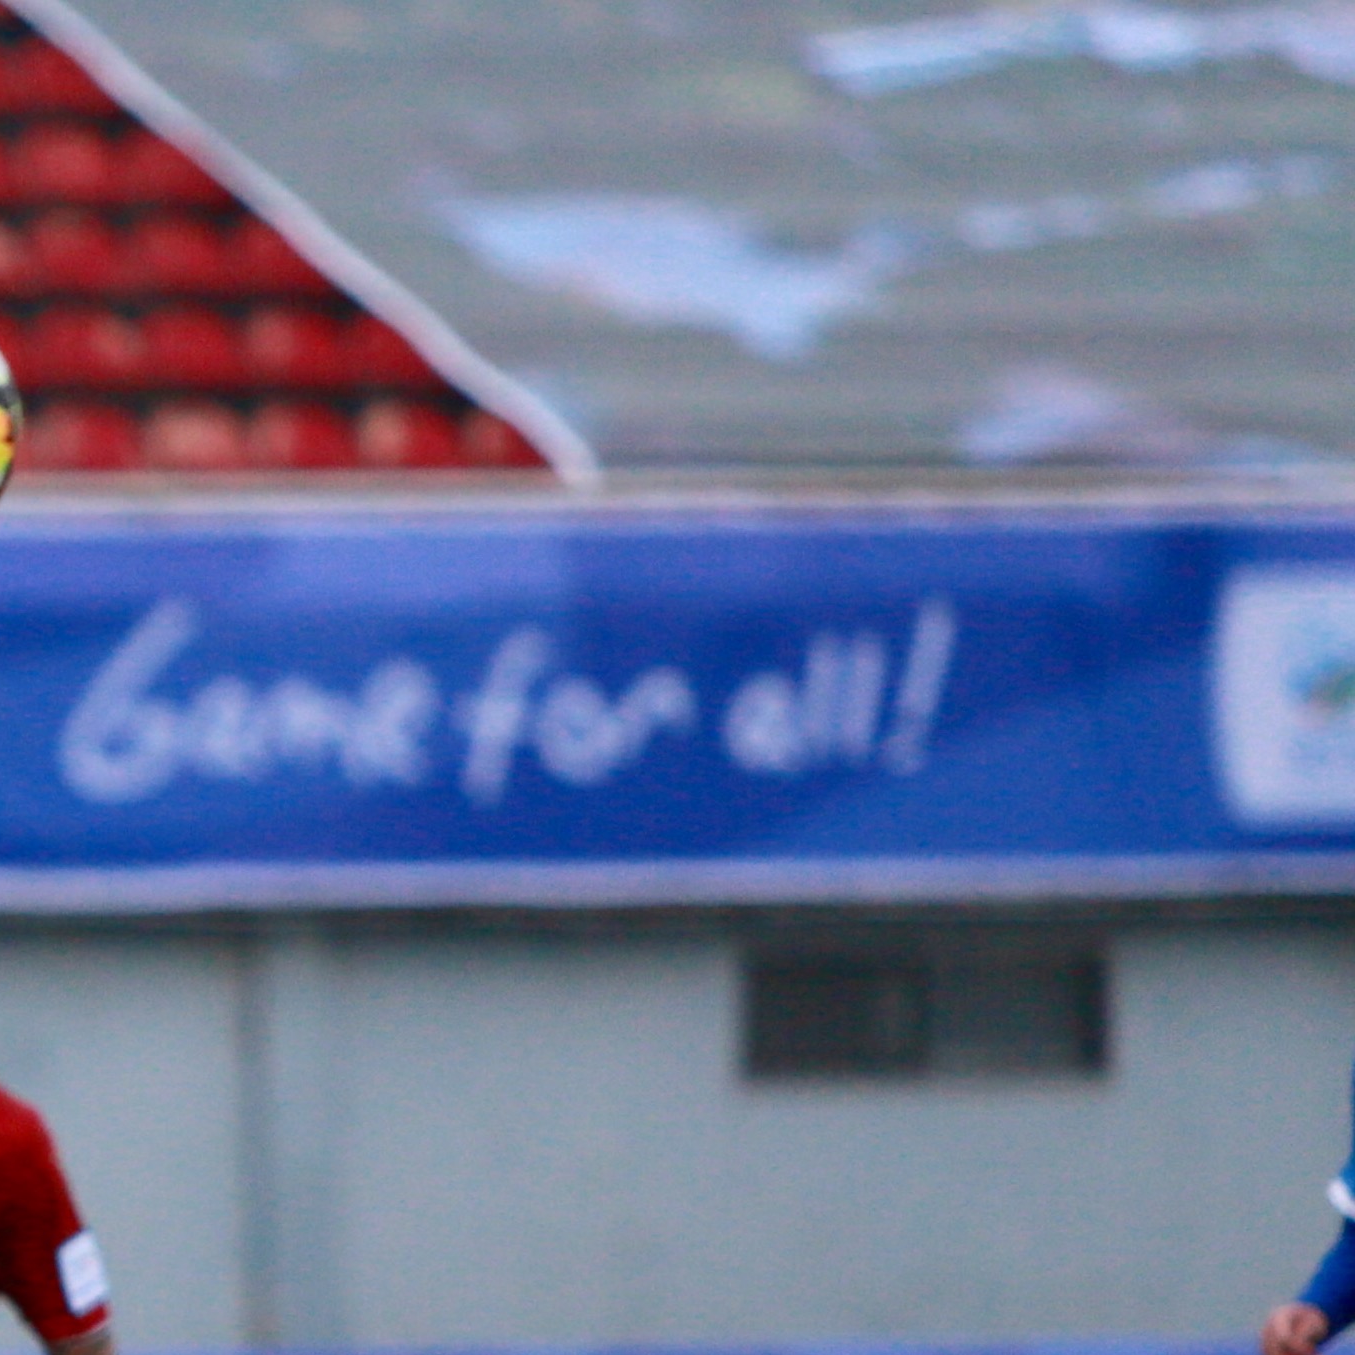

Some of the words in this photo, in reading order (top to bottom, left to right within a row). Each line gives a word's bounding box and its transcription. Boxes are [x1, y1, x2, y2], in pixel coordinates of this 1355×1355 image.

[57, 598, 439, 802] Game
[457, 626, 695, 800] for
[722, 596, 955, 772] all!
